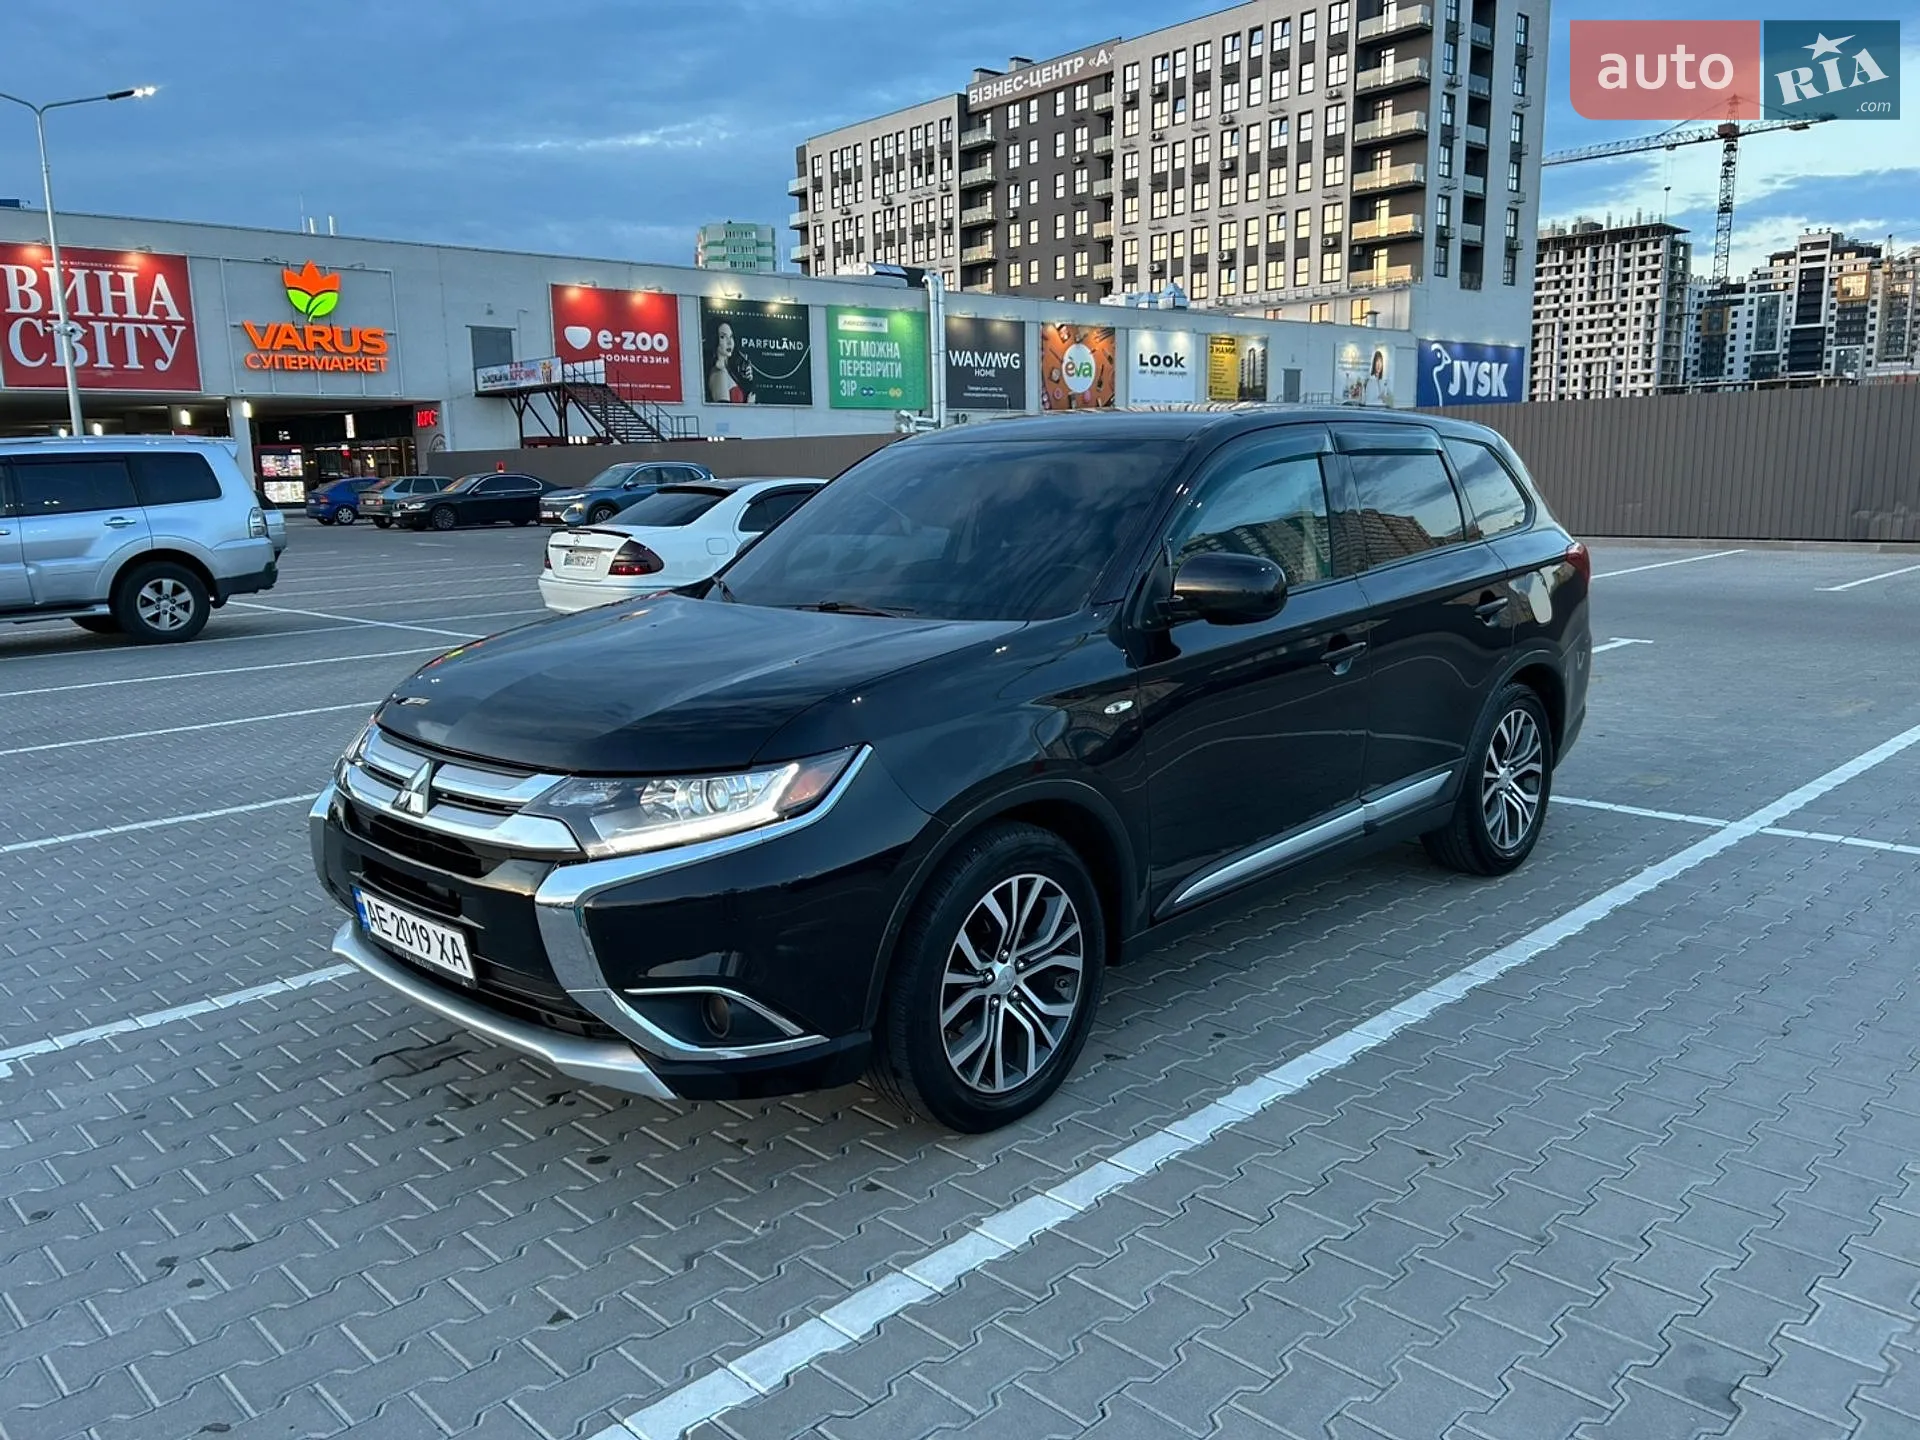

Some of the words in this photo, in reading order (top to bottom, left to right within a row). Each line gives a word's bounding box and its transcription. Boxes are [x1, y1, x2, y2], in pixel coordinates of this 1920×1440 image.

[969, 56, 1085, 106] БІЗНЕС-ЦЕНТР
[0, 264, 185, 321] ВИНА
[8, 317, 187, 372] СВІТУ
[243, 320, 388, 354] VARUS
[838, 340, 858, 357] ТУТ
[860, 340, 900, 359] МОЖНА
[245, 353, 389, 373] СУПЕРМАРКЕТ
[839, 359, 902, 379] ПЕРЕВІРИТИ
[975, 369, 996, 378] HOME
[840, 379, 857, 397] ЗІР
[1448, 360, 1508, 397] JYSK
[417, 408, 438, 427] KFC
[391, 912, 431, 954] 2019
